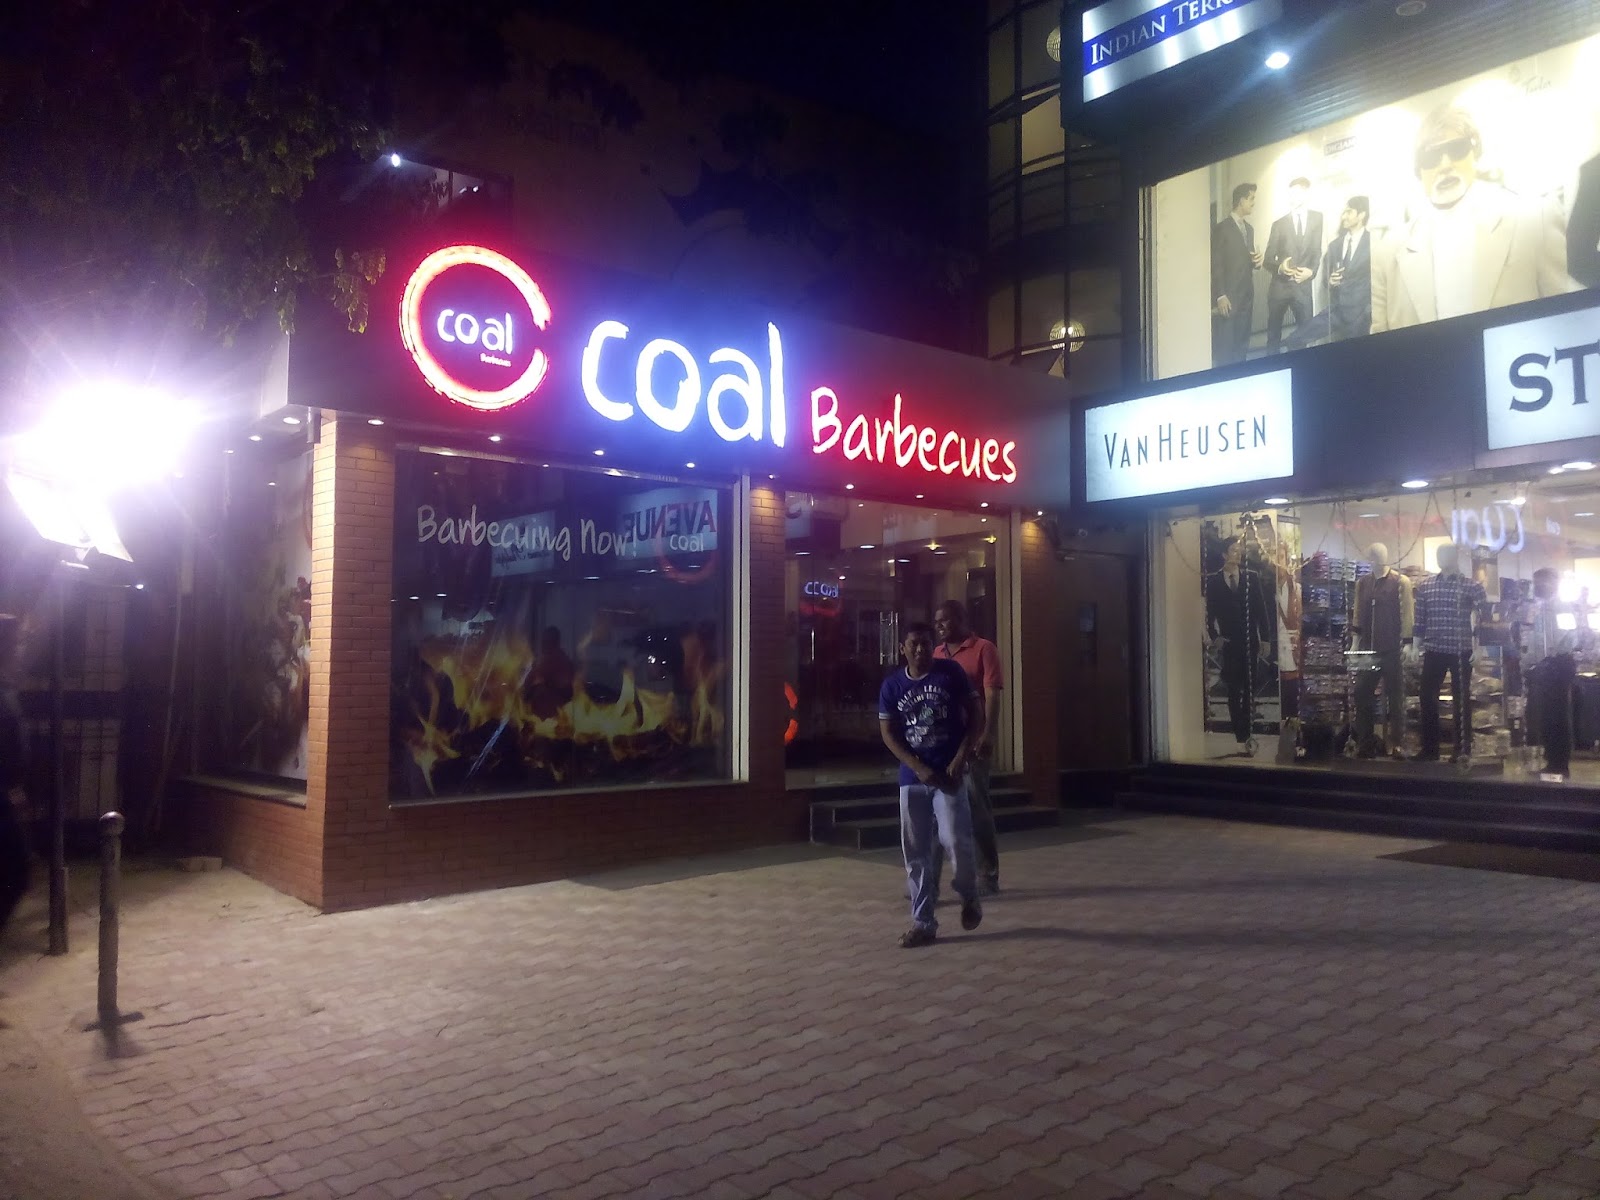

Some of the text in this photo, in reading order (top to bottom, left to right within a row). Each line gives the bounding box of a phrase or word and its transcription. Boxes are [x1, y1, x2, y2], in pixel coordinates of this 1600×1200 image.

[1091, 15, 1166, 65] INDIAN
[436, 308, 514, 355] coal
[581, 320, 787, 448] coal
[1509, 339, 1600, 412] ST
[810, 386, 1017, 484] Barbecues
[1104, 413, 1267, 470] VAN HEUSEN
[417, 503, 571, 562] Barbecuing
[670, 533, 704, 552] coal
